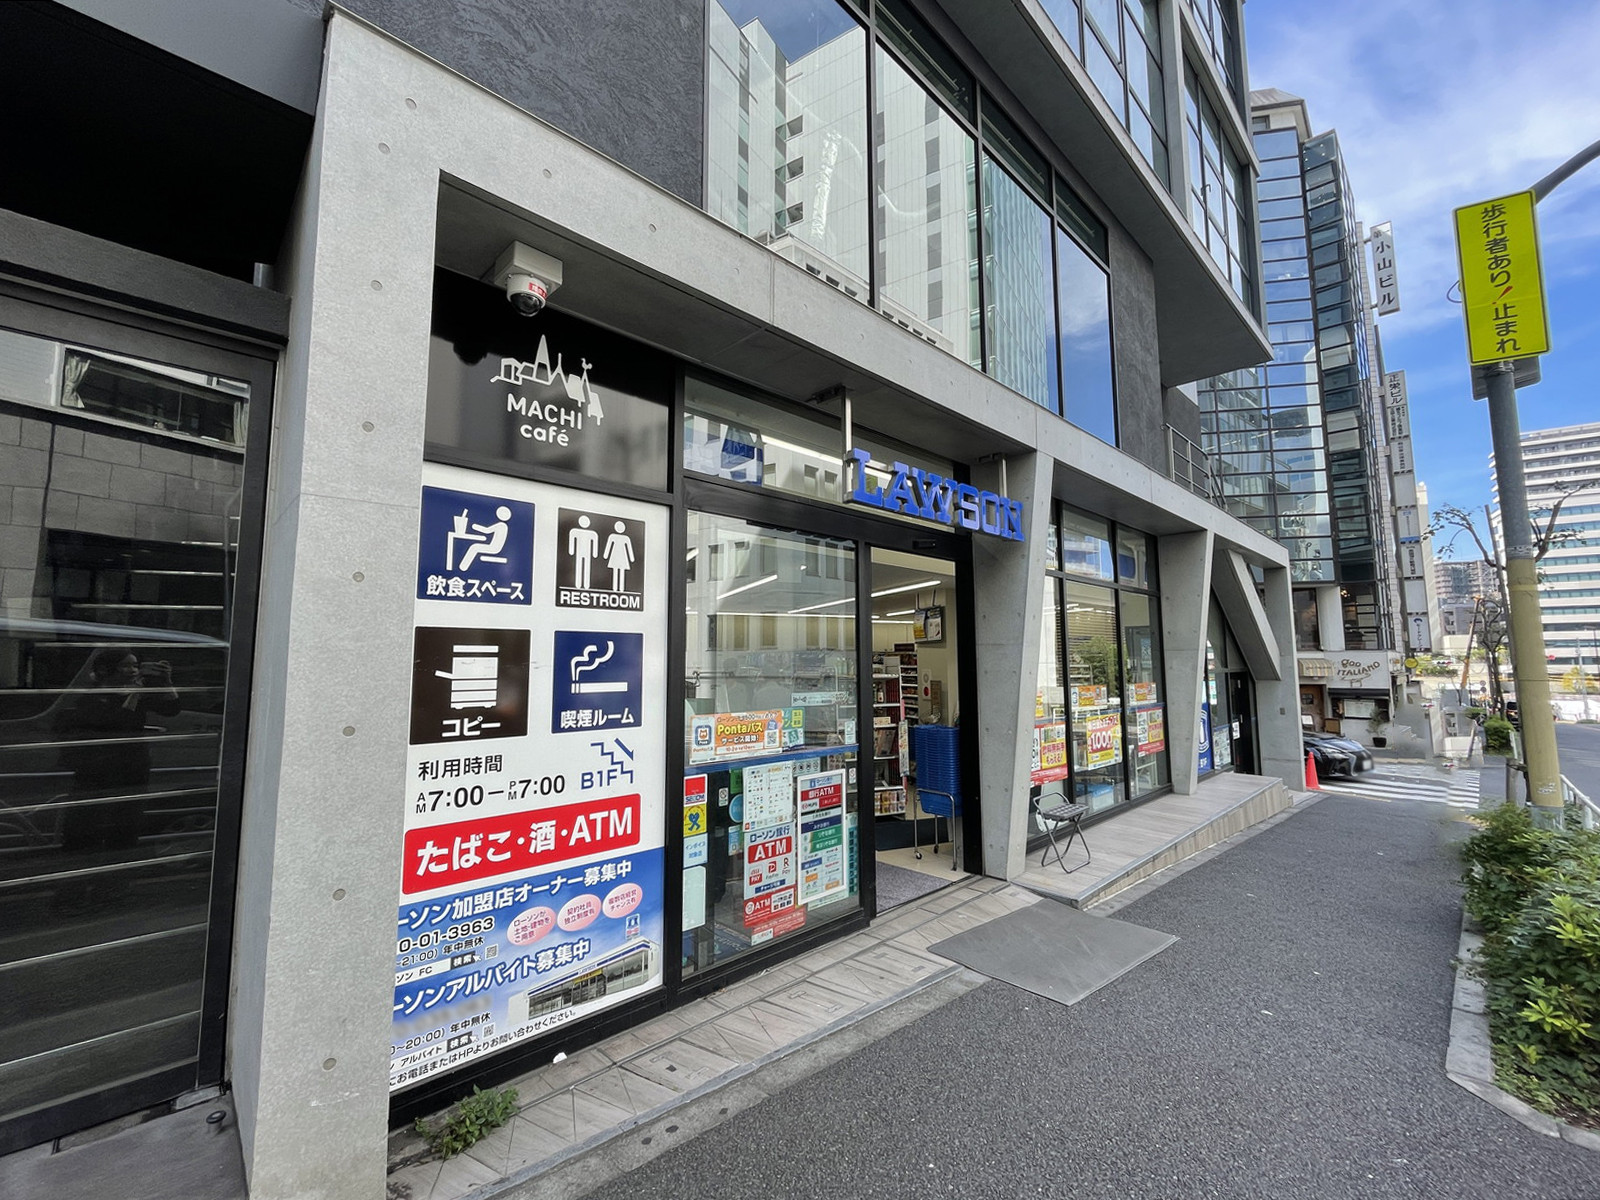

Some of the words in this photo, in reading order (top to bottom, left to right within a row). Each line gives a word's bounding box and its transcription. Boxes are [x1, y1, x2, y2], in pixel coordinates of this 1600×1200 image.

[507, 393, 582, 430] MACHI
[520, 424, 569, 446] café
[846, 447, 1025, 542] LAWSON
[426, 575, 525, 600] 飲食スペース
[560, 591, 640, 609] RESTROOM
[442, 716, 501, 737] コピー
[560, 708, 634, 729] 喫煙ルーム
[417, 754, 503, 781] 利用時間
[581, 769, 617, 790] B1F
[685, 794, 705, 802] SECOM
[416, 806, 632, 877] たばこ・酒・ATM
[754, 839, 787, 860] ATM
[755, 898, 770, 910] ATM
[443, 936, 484, 955] 年中無休
[419, 966, 433, 977] FC
[450, 1012, 491, 1033] 年中無休
